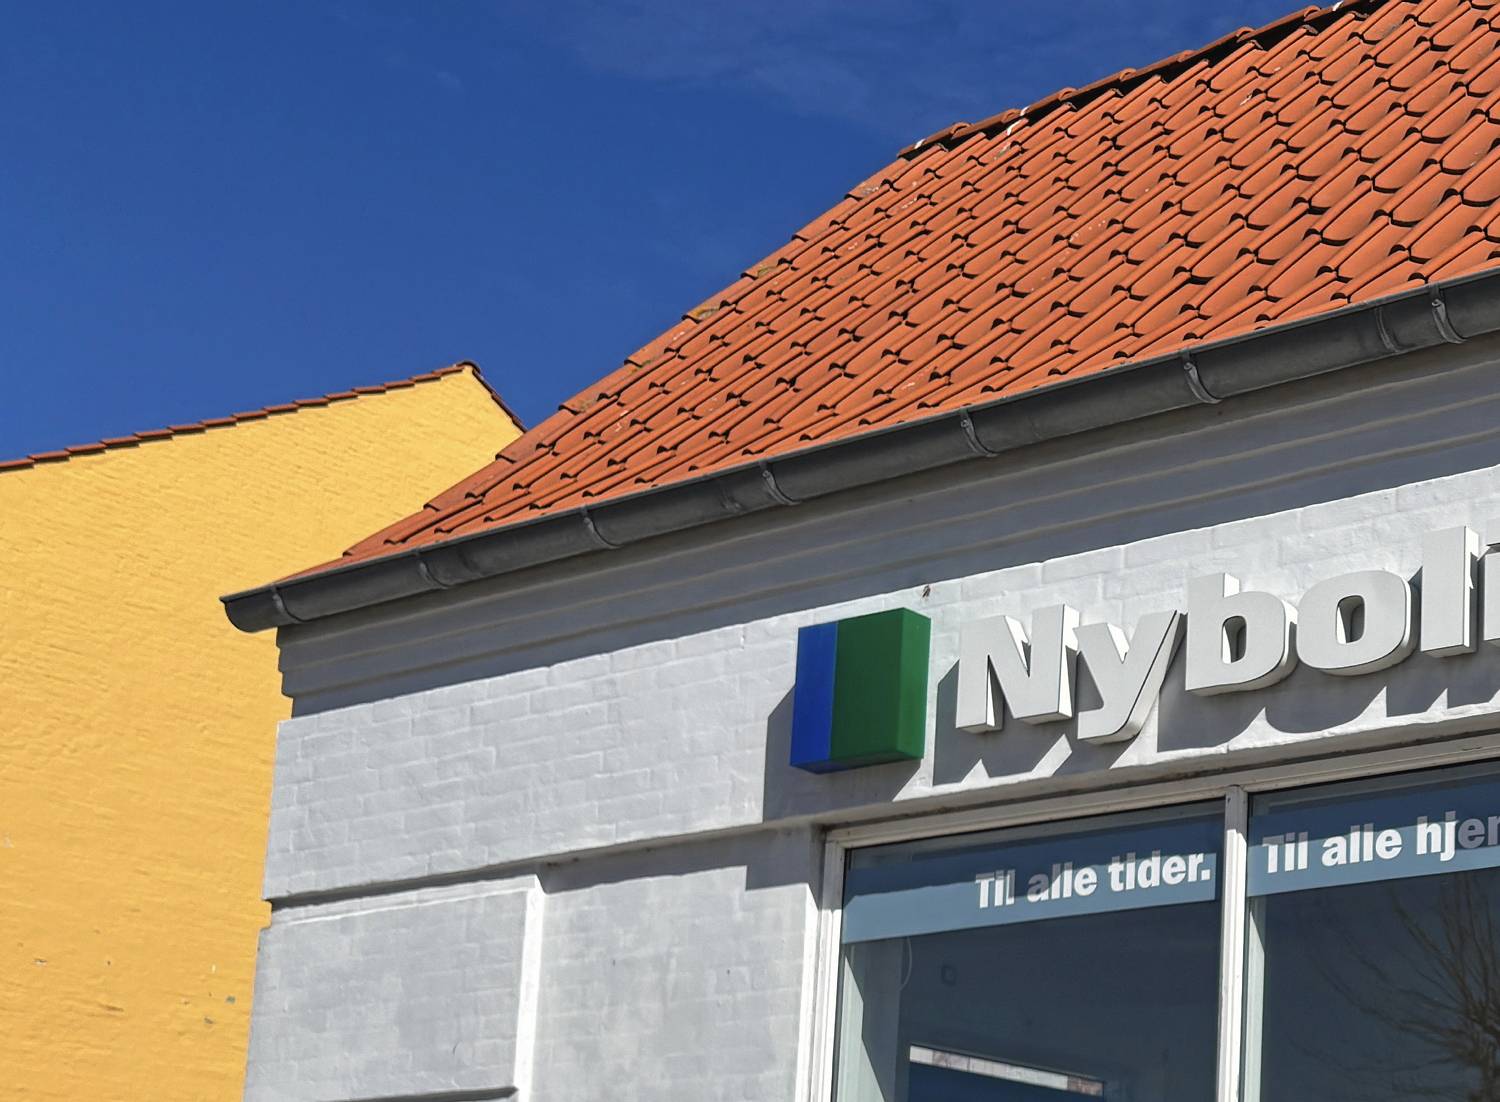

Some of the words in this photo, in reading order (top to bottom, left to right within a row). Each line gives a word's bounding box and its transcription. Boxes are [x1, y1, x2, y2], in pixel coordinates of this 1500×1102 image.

[1262, 831, 1309, 874] Til
[1321, 823, 1402, 867] alle
[975, 869, 1016, 909] Til
[1027, 861, 1097, 903] alle
[1107, 850, 1211, 892] tider.
